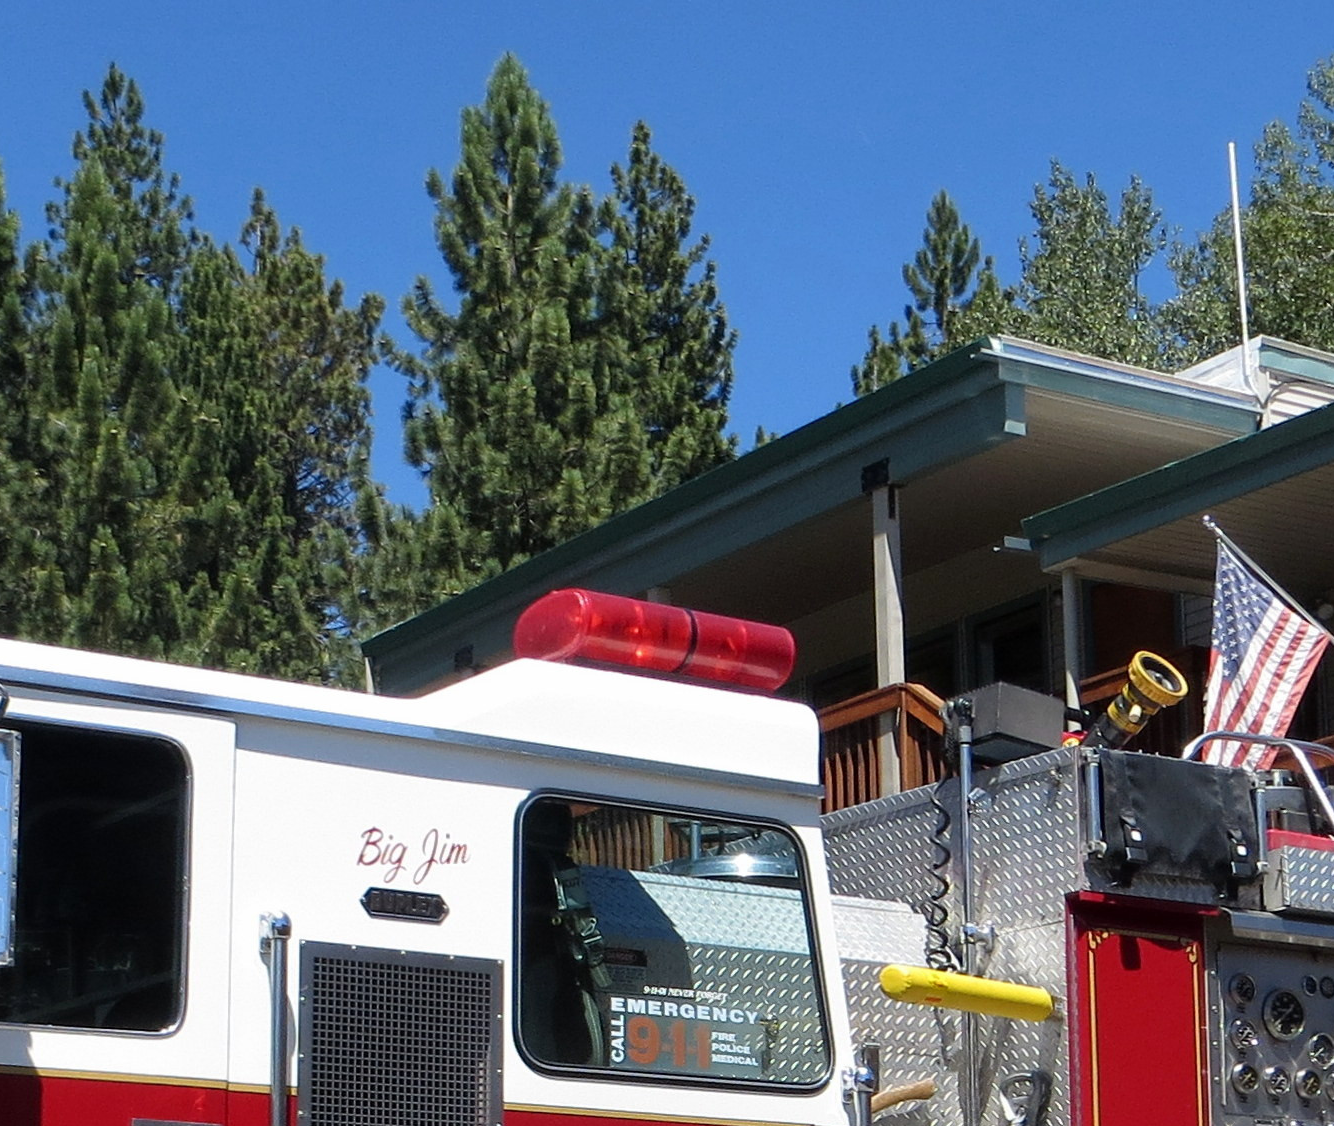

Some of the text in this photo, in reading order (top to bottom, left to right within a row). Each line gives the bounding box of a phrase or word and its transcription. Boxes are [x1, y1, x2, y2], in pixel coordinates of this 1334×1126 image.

[356, 826, 471, 885] Big Jim
[667, 988, 695, 998] NEVER
[610, 996, 759, 1025] EMERGENCY
[610, 1014, 625, 1064] CALL
[711, 1031, 736, 1042] FIRE
[712, 1043, 751, 1054] POLICE
[711, 1054, 759, 1067] MEDICAL
